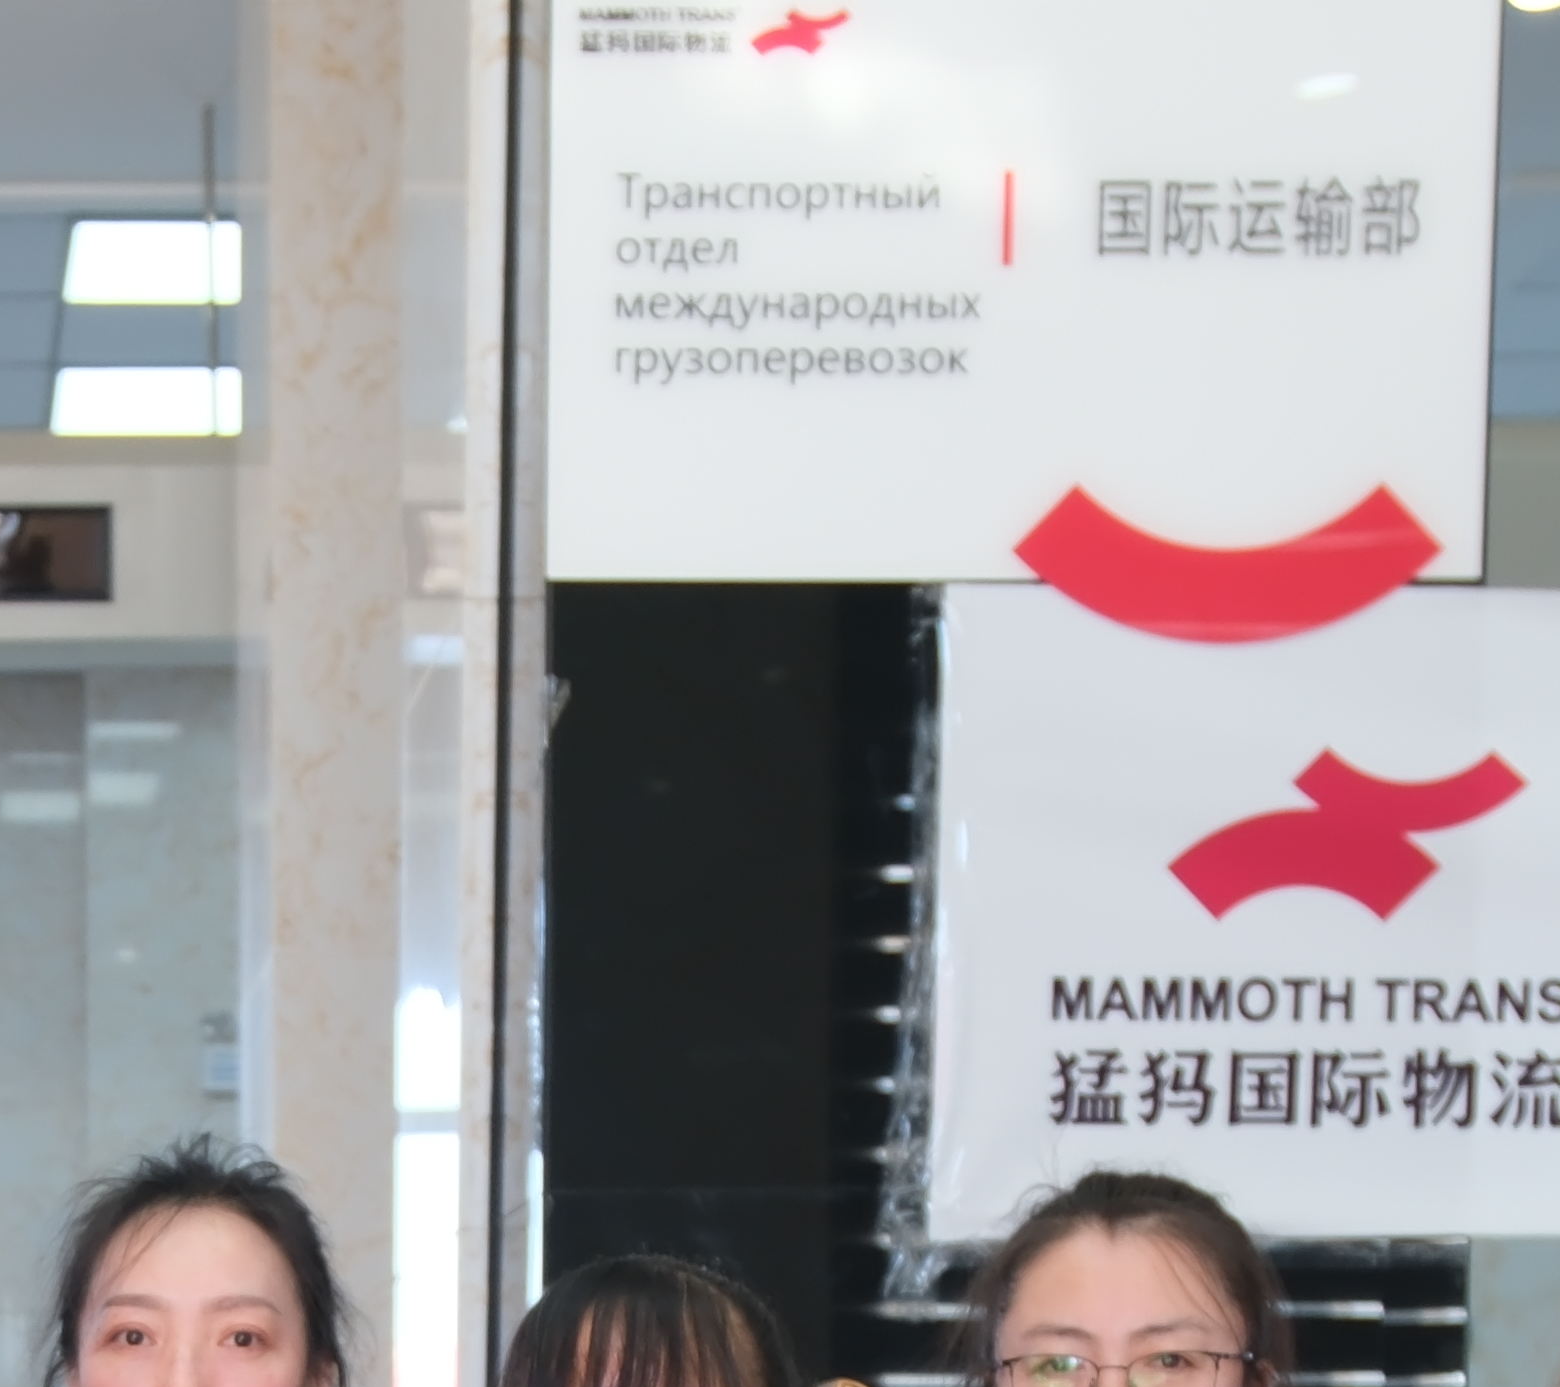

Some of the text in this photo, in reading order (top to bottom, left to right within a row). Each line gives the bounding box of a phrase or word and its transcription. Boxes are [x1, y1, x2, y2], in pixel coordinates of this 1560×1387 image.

[617, 171, 941, 219] Транспортный
[1094, 176, 1422, 258] 国际运输部
[615, 235, 740, 272] отдел
[613, 290, 982, 330] международных
[613, 344, 970, 385] грузоперевозок
[1050, 975, 1355, 1024] MAMMOTH
